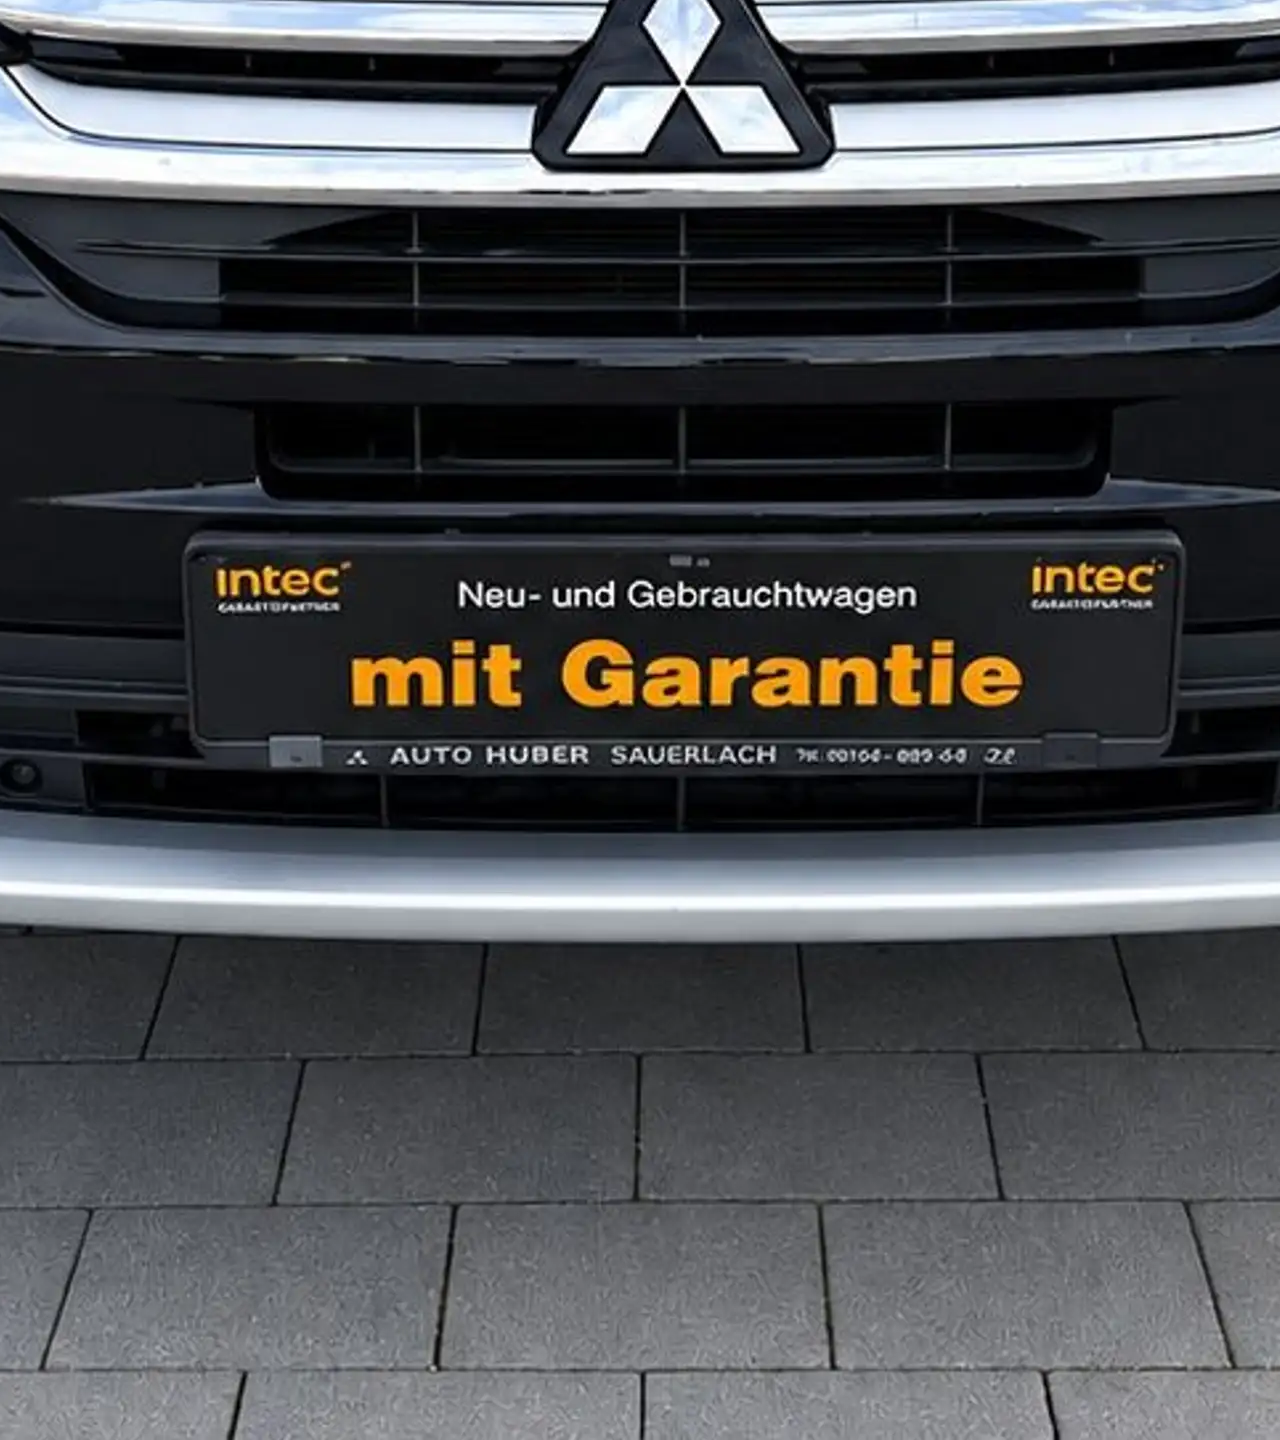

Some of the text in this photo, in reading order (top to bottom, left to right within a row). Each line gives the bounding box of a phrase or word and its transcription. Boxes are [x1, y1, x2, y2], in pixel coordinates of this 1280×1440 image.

[216, 564, 340, 596] intec
[1032, 561, 1154, 594] intec
[458, 580, 917, 615] Neu- und Gebrauchtwagen
[351, 639, 1023, 708] mit Garantie
[390, 746, 472, 765] AUTO
[486, 745, 589, 765] HUBER
[611, 745, 777, 765] SAUERLACH
